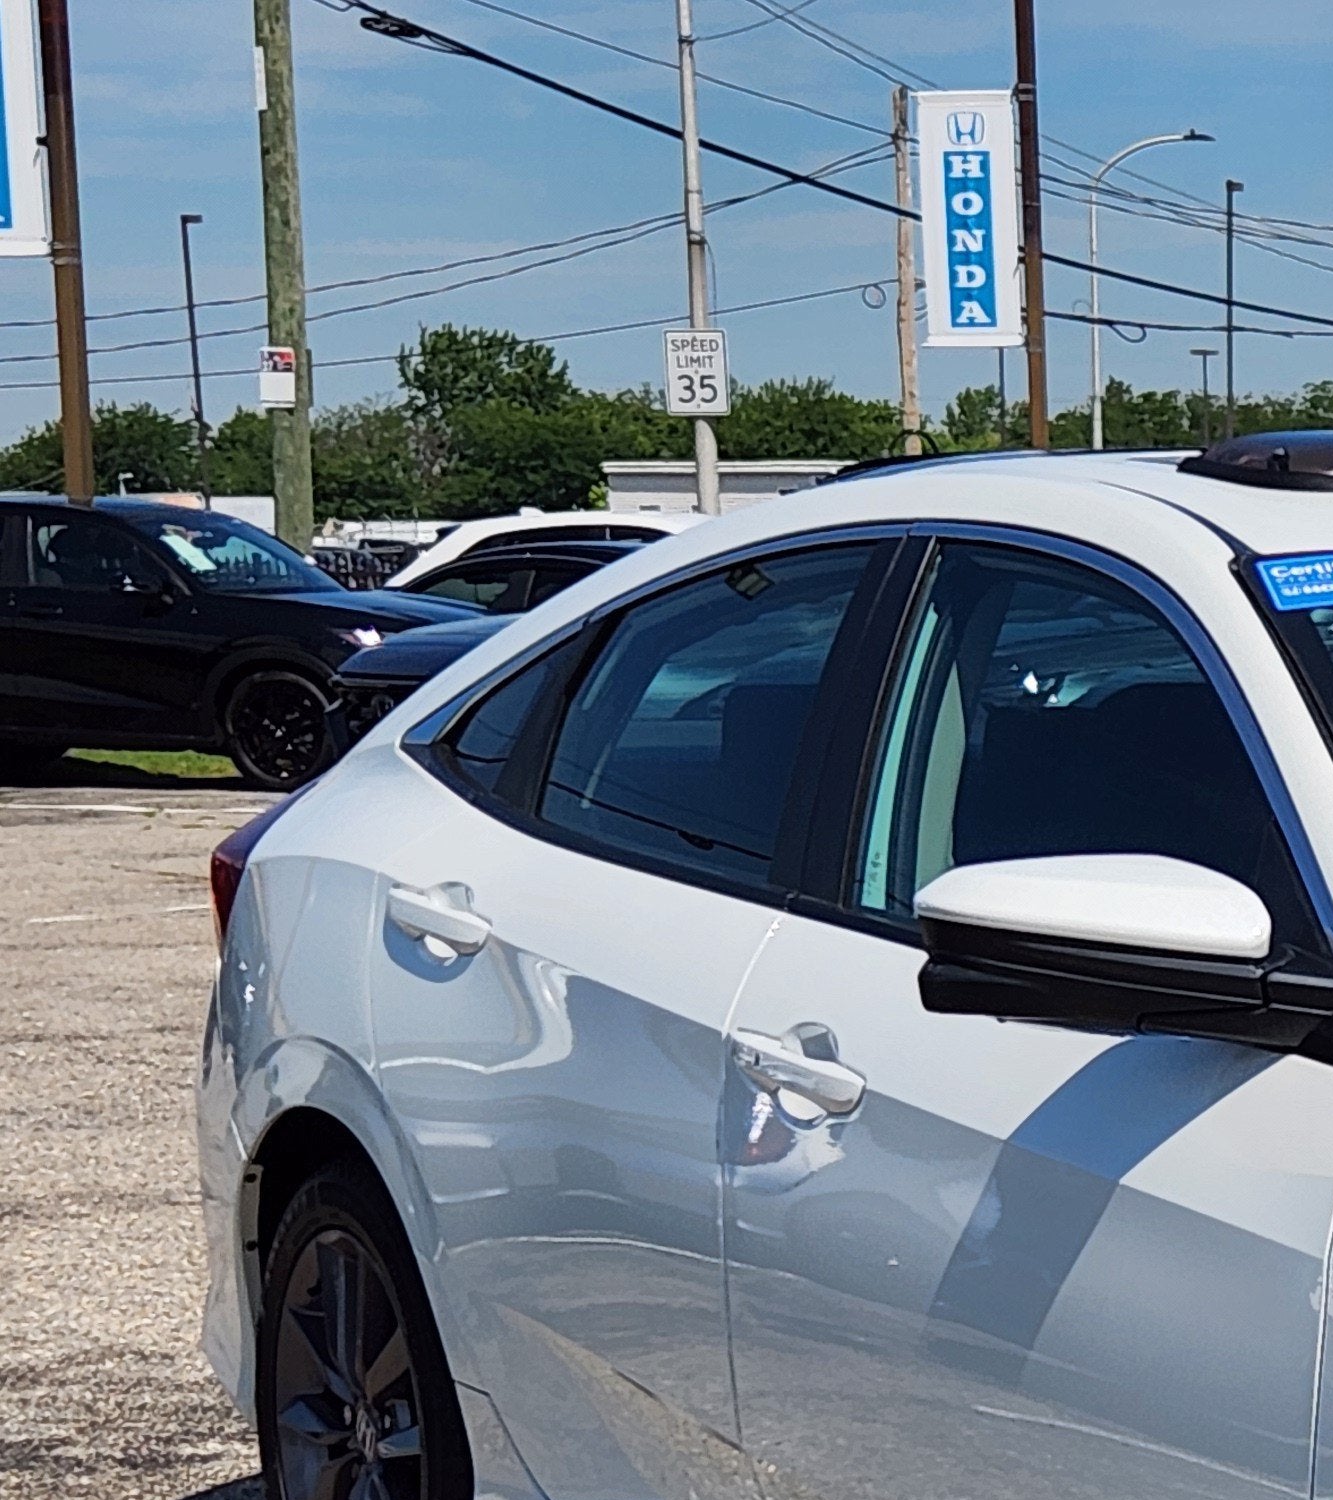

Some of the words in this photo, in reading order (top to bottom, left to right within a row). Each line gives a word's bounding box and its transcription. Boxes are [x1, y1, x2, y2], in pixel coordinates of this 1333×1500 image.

[948, 154, 991, 323] HONDA
[670, 338, 719, 353] SPEED
[676, 354, 714, 369] LIMIT
[677, 374, 718, 403] 35
